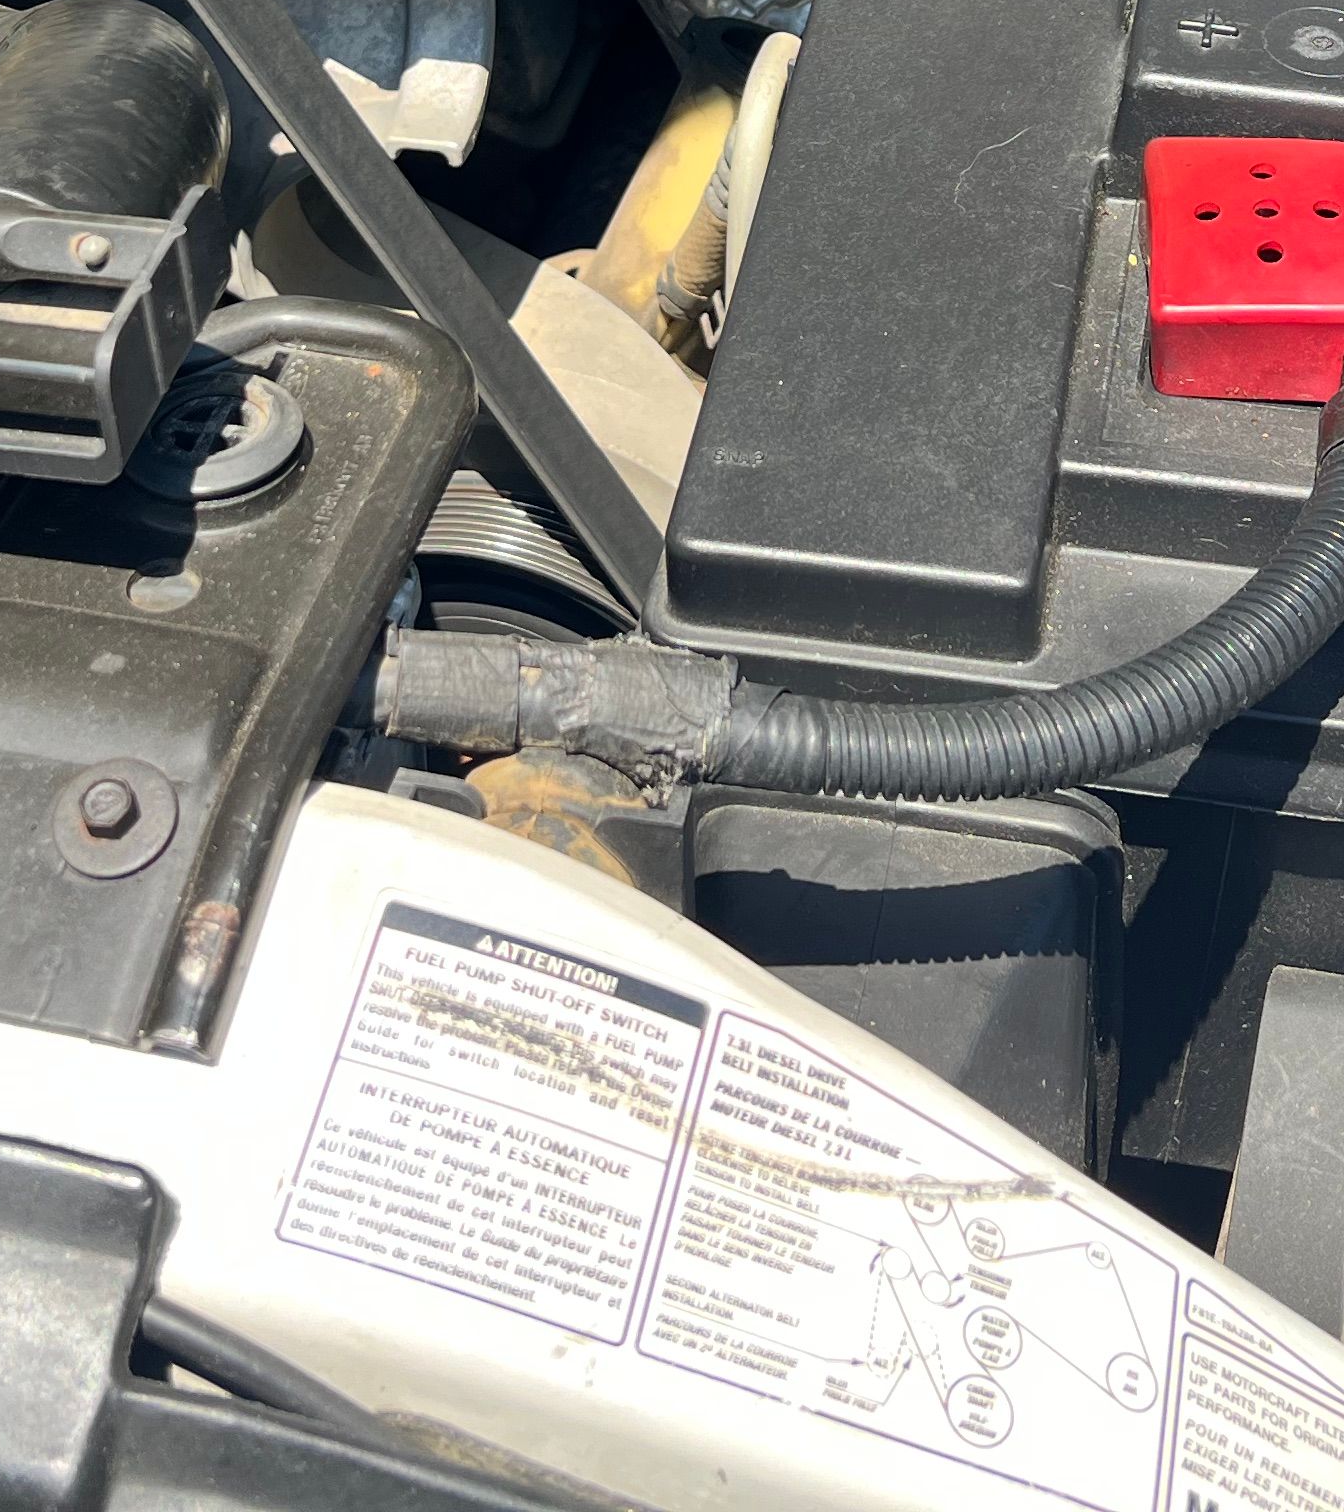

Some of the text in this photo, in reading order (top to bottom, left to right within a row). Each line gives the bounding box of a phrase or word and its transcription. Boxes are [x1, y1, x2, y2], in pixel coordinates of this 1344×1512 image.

[404, 945, 448, 971] FUEL
[454, 959, 507, 988] PUMP
[509, 975, 596, 1017] SHUT-OFF
[598, 1006, 669, 1043] SWITCH
[493, 937, 619, 994] ATTENTION!
[374, 961, 405, 982] This
[409, 972, 460, 999] vehicle
[482, 993, 549, 1027] equipped
[553, 1016, 586, 1037] with
[603, 1032, 639, 1056] FUEL
[643, 1047, 685, 1073] PUMP
[447, 1043, 501, 1071] switch
[512, 1064, 577, 1096] location
[587, 1088, 618, 1110] and
[720, 1051, 851, 1111] BELT INSTALLATION
[756, 1045, 804, 1074] DIESEL
[806, 1064, 847, 1090] DRIVE
[358, 1076, 633, 1181] INTERRUPTEUR AUTOMATIQUE
[388, 1108, 592, 1186] DE POMPE ESSENCE
[709, 1097, 769, 1130] MOTEUR
[769, 1119, 818, 1148] DIESEL
[714, 1078, 903, 1160] PARCOURS DE LA COURROIE
[315, 1132, 428, 1182] AUTOMATIQUE
[433, 1169, 455, 1188] DE
[459, 1177, 516, 1208] POMPE
[537, 1202, 610, 1240] ESSENCE
[532, 1181, 644, 1230] INTERRUPTEUR
[1188, 1368, 1208, 1390] UP
[1213, 1381, 1257, 1416] PARTS
[1260, 1406, 1289, 1433] FOR
[1190, 1349, 1218, 1376] USE
[1220, 1365, 1309, 1425] MOTORCRAFT
[1182, 1435, 1239, 1476] EXIGER
[1243, 1466, 1271, 1493] LES
[1185, 1416, 1228, 1451] POUR
[1233, 1441, 1254, 1464] UN
[1180, 1454, 1216, 1485] MISE
[1218, 1473, 1238, 1496] AU
